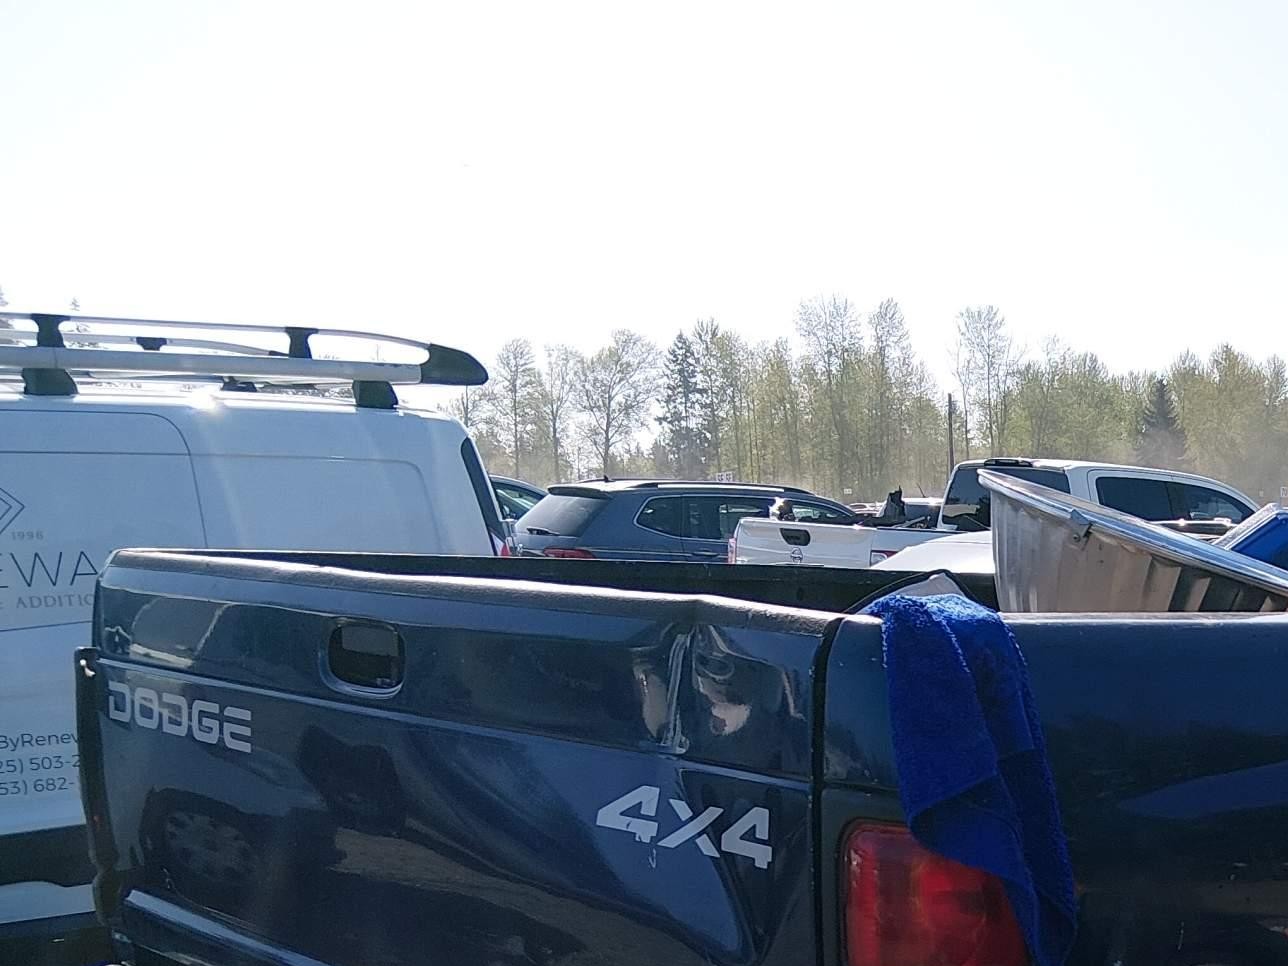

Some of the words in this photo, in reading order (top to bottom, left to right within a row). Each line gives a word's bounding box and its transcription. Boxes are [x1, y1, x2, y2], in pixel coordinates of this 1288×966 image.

[11, 530, 45, 541] 1996
[108, 680, 252, 754] DODGE
[596, 785, 773, 870] 4X4
